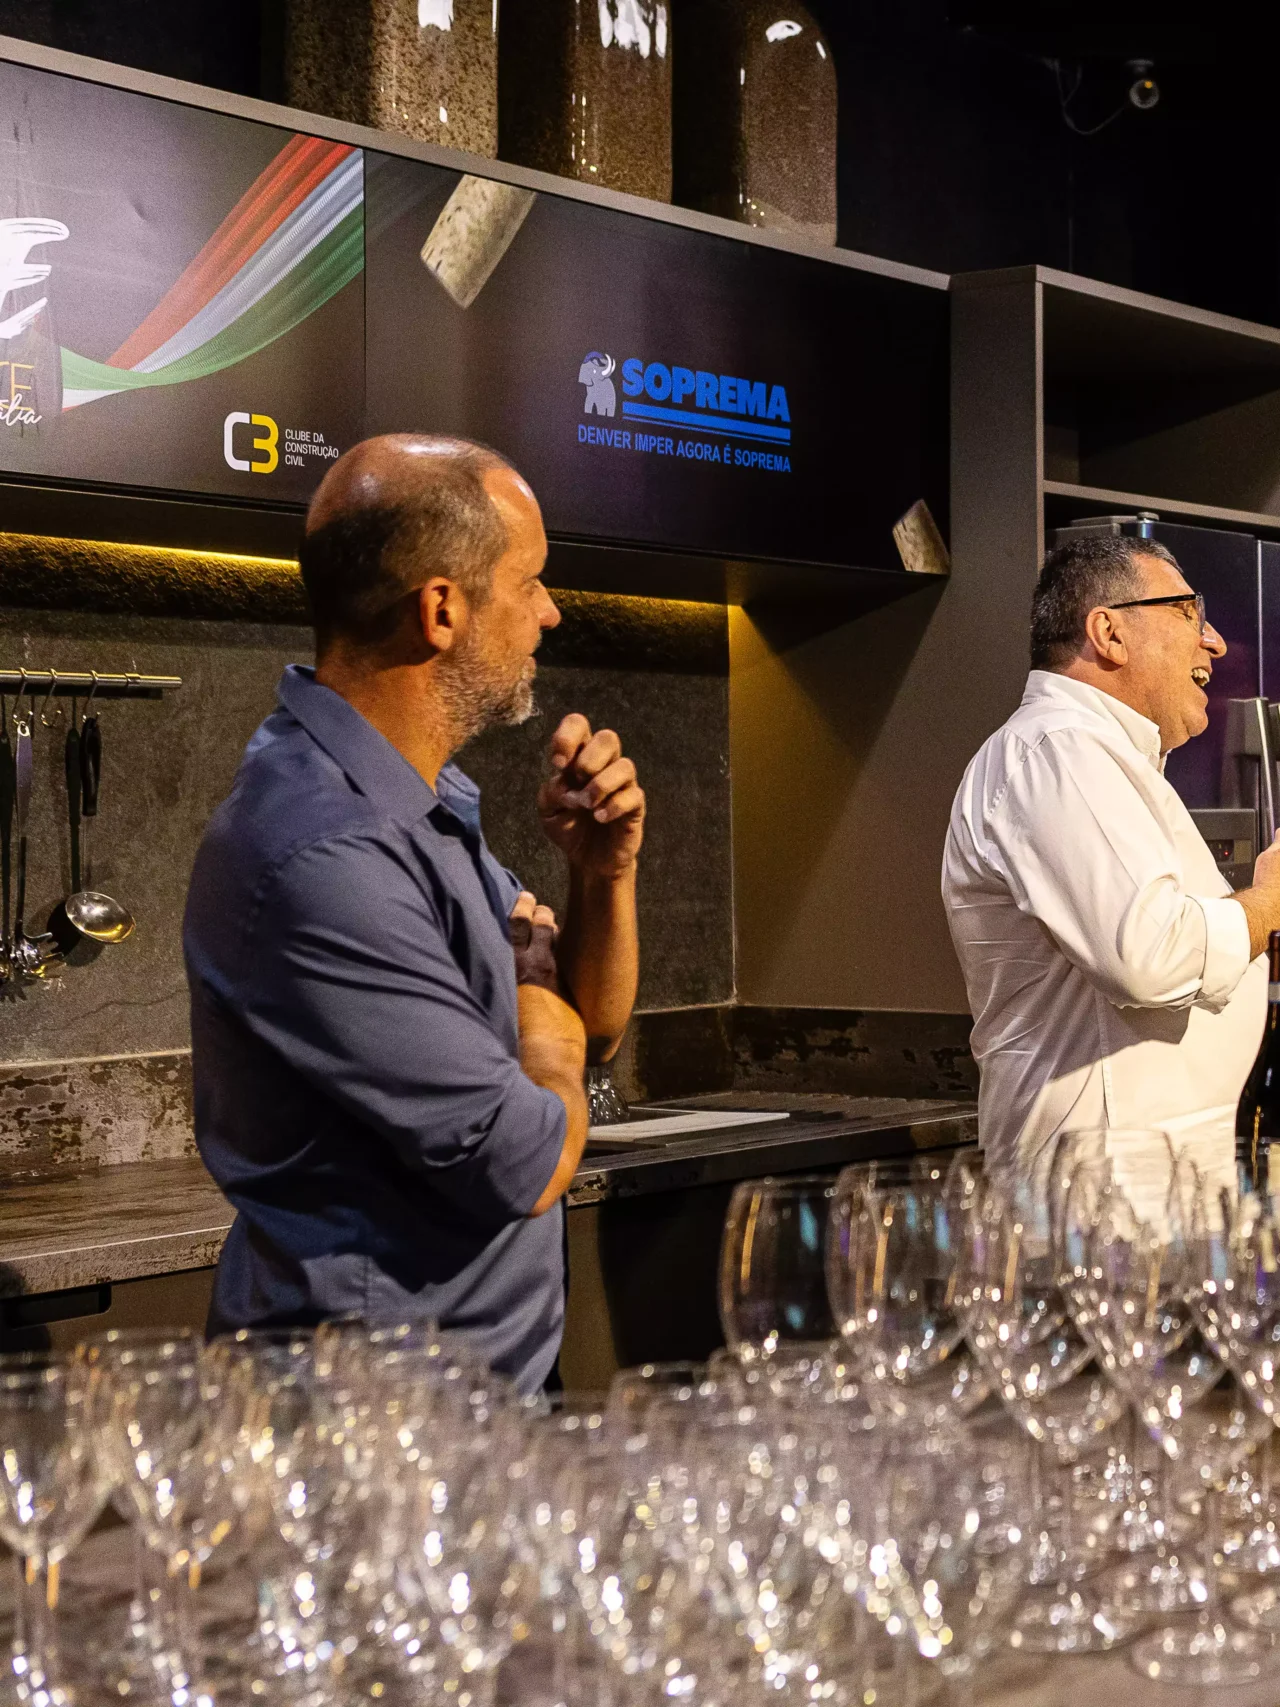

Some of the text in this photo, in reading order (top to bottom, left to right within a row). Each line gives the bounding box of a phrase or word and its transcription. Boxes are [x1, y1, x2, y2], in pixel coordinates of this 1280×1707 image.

[622, 358, 791, 422] SOPREMA
[285, 428, 325, 444] CLUBE DA
[285, 441, 339, 459] CONSTRUÇÃO
[578, 424, 791, 473] DENVER IMPER AGORA É SOPREMA
[285, 454, 305, 467] CIVIL
